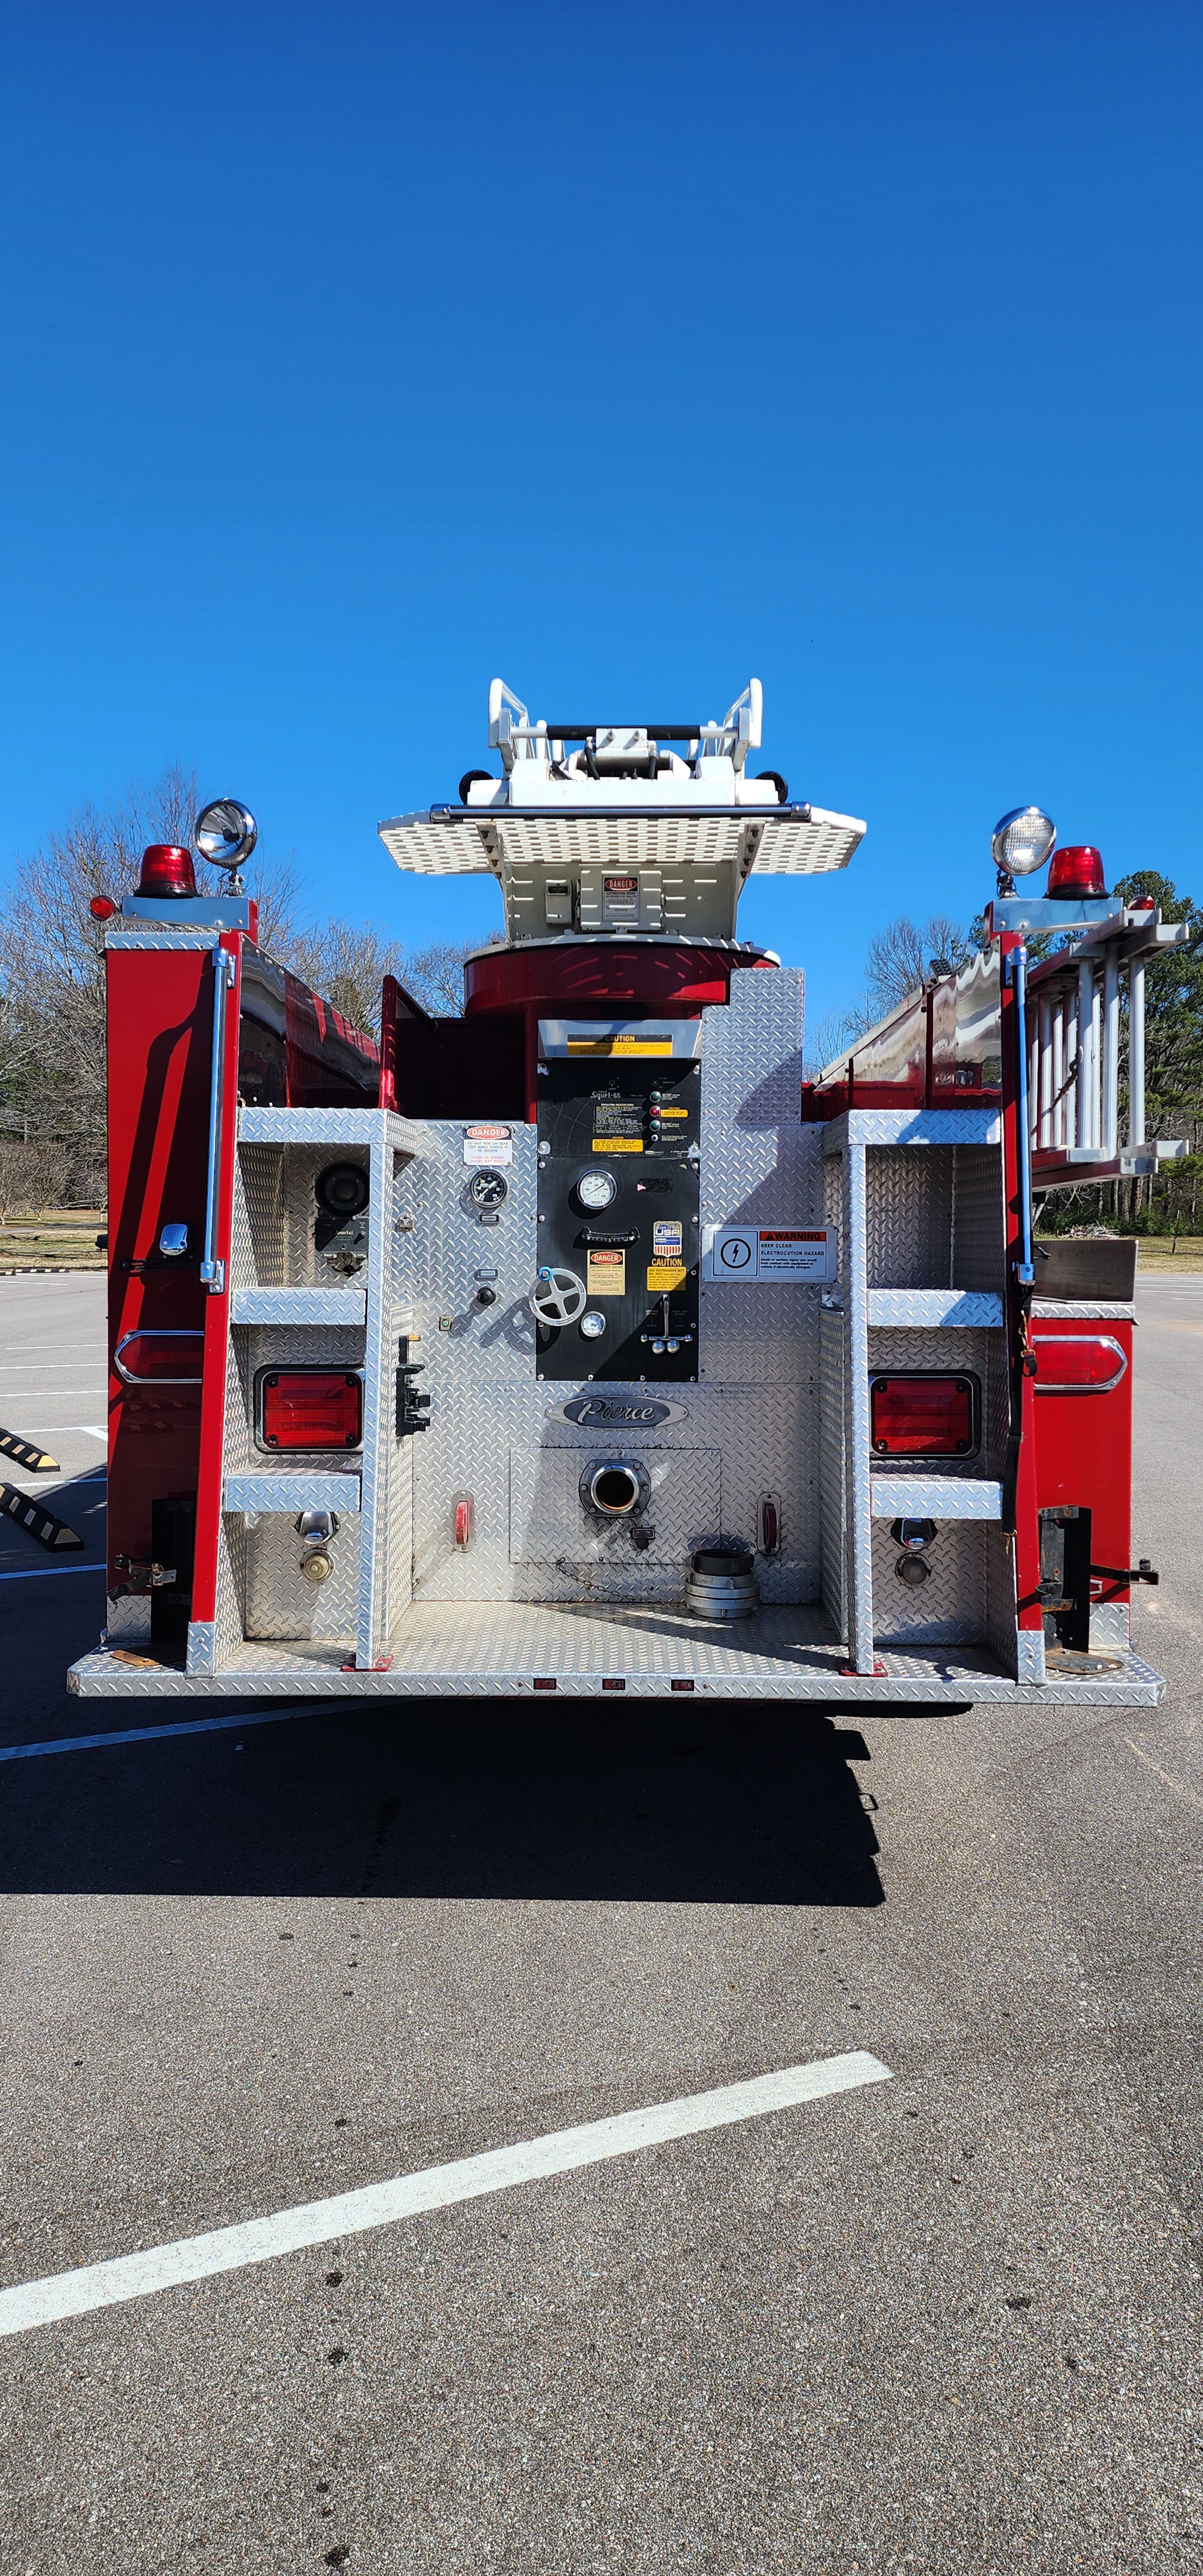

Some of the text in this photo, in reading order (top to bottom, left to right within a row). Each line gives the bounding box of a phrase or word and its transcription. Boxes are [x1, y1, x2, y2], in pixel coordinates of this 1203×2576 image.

[610, 880, 633, 888] DANGER
[652, 1258, 682, 1266] CAUTION
[577, 1399, 655, 1424] Pierce
